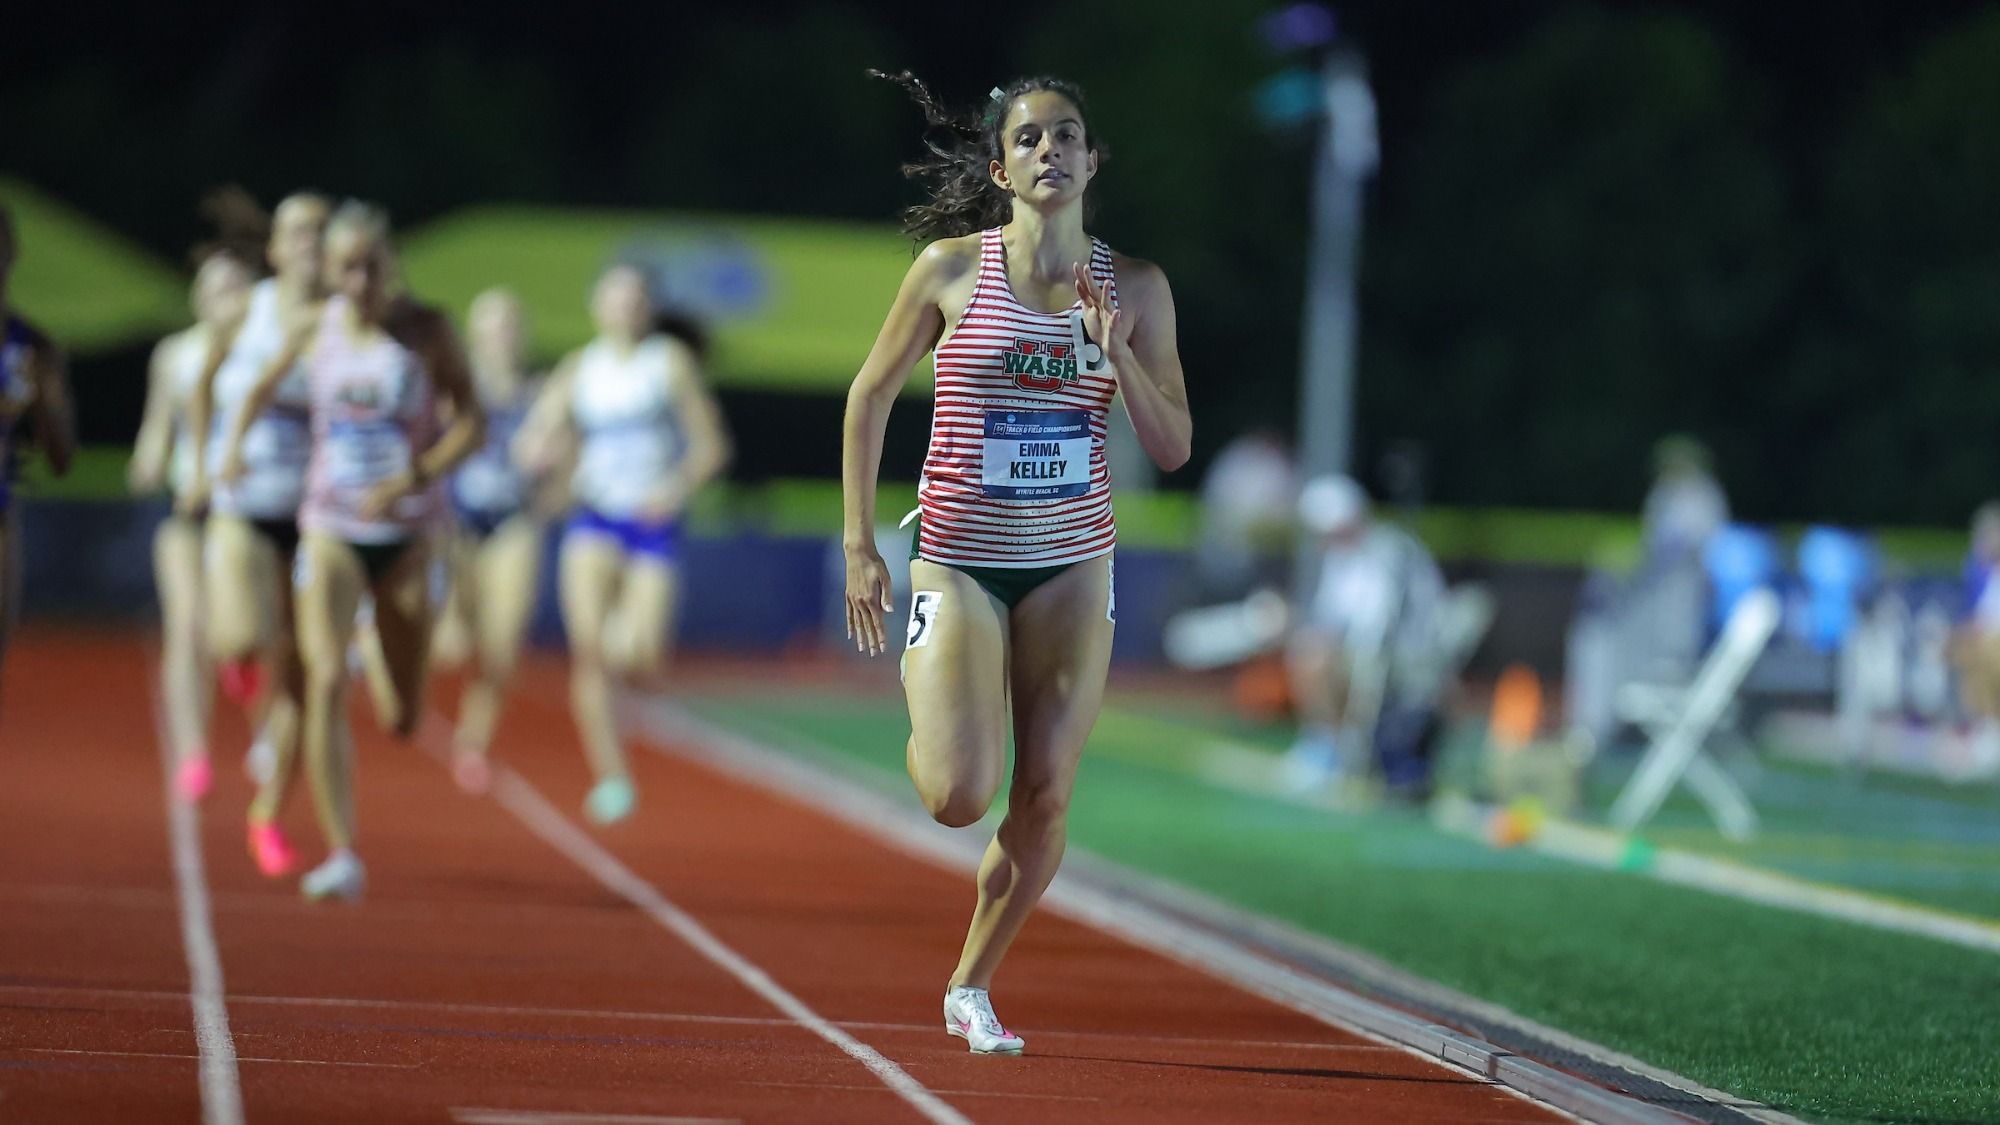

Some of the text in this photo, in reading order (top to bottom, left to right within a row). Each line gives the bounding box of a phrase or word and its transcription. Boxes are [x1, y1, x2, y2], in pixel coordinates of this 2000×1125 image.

[1003, 350, 1079, 382] WASH
[1019, 443, 1061, 457] EMMA
[1010, 460, 1067, 479] KELLEY
[909, 595, 932, 646] 5
